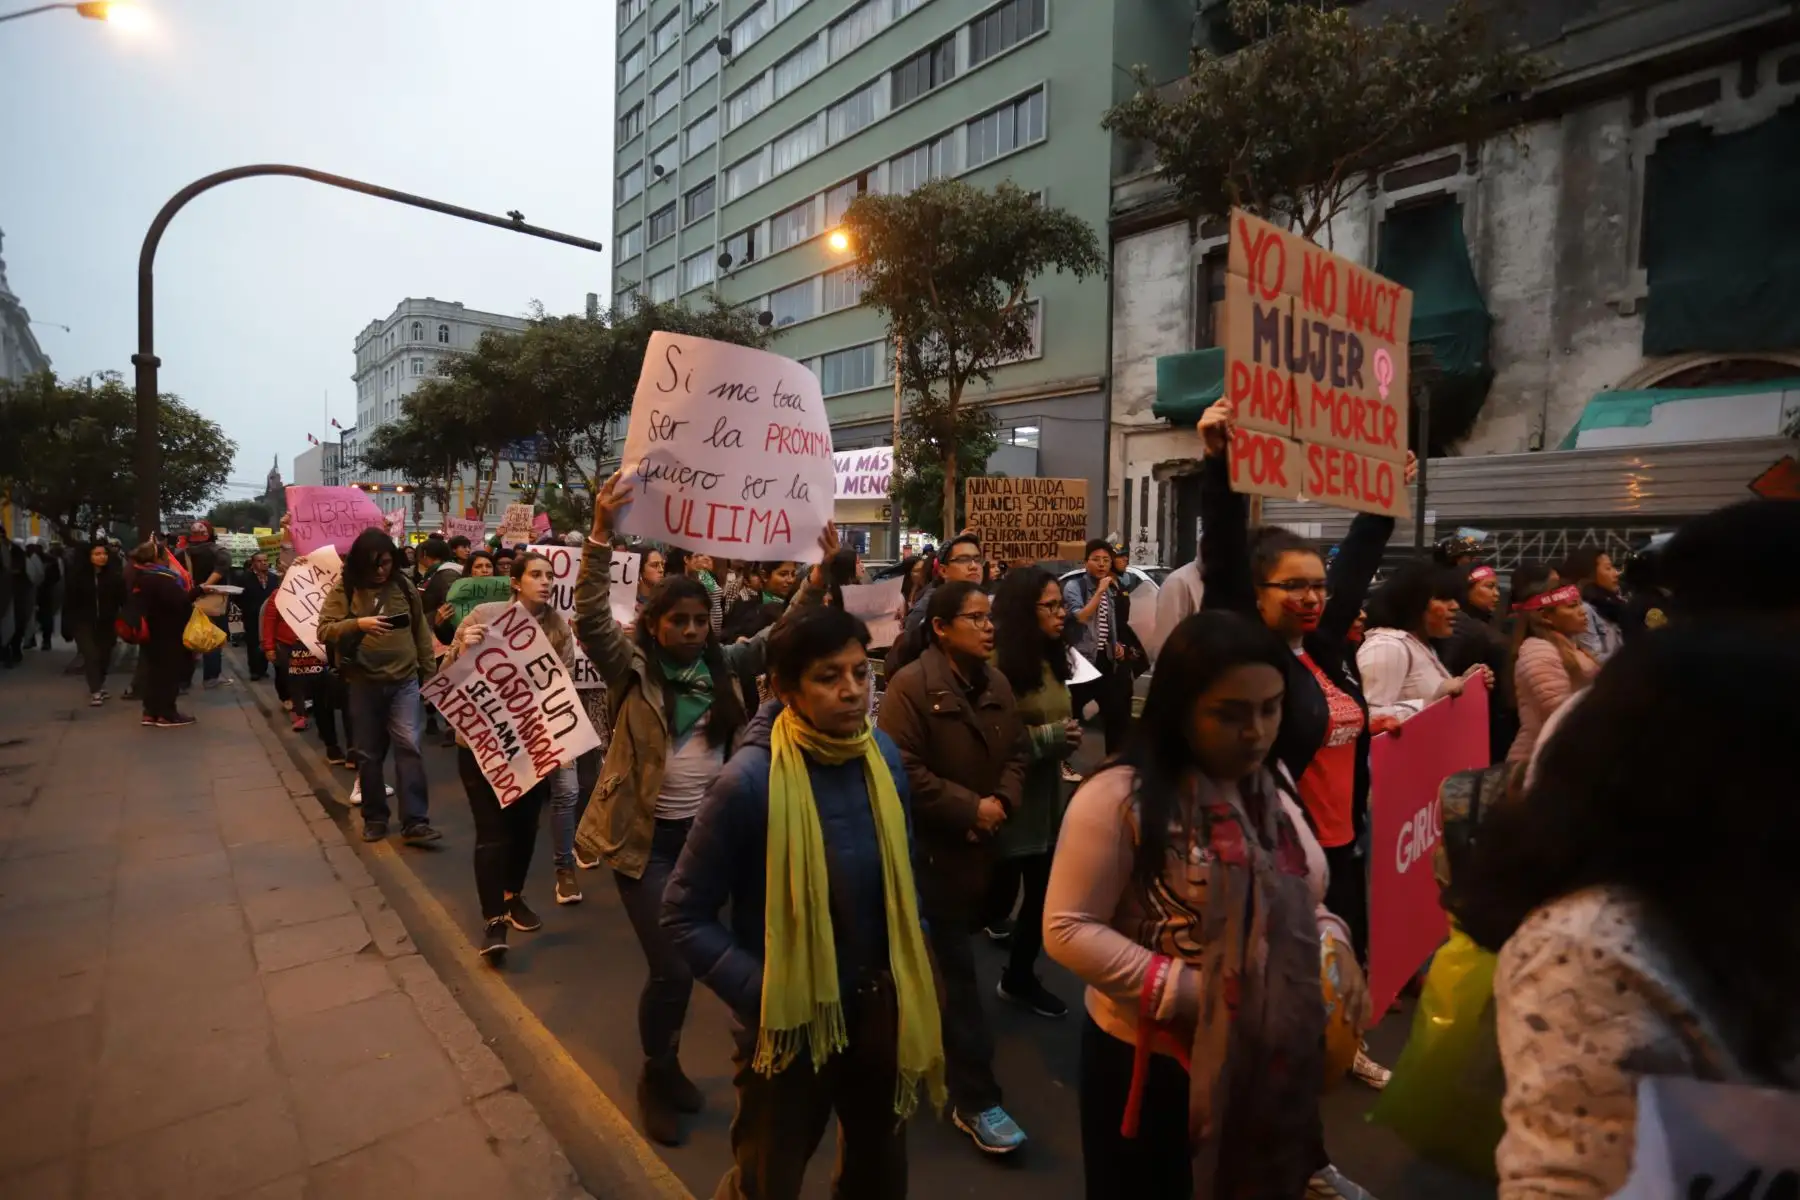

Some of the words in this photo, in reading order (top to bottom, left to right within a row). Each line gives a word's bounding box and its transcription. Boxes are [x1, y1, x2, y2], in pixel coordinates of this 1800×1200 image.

[1238, 217, 1286, 301] YO
[1302, 251, 1338, 320] NO
[1252, 301, 1364, 390] MUJER
[708, 381, 761, 403] me
[1231, 360, 1303, 429] PARA
[1310, 383, 1398, 451] MORIR
[702, 415, 745, 449] la
[764, 421, 832, 460] PRÓXIMA
[636, 457, 725, 496] quiero
[741, 474, 779, 500] ser
[784, 473, 812, 503] la
[969, 479, 1012, 495] NUNCA
[1232, 427, 1288, 489] POR
[1307, 443, 1394, 511] SERLO
[294, 500, 368, 524] LIBRE
[664, 485, 792, 545] ÚLTIMA
[970, 512, 1023, 527] SIEMPRE
[972, 497, 1022, 512] NUNCA
[295, 524, 312, 540] NO
[983, 542, 1058, 560] FEMINICIDA
[492, 607, 537, 651] NO
[420, 674, 523, 806] PATRIARCADO
